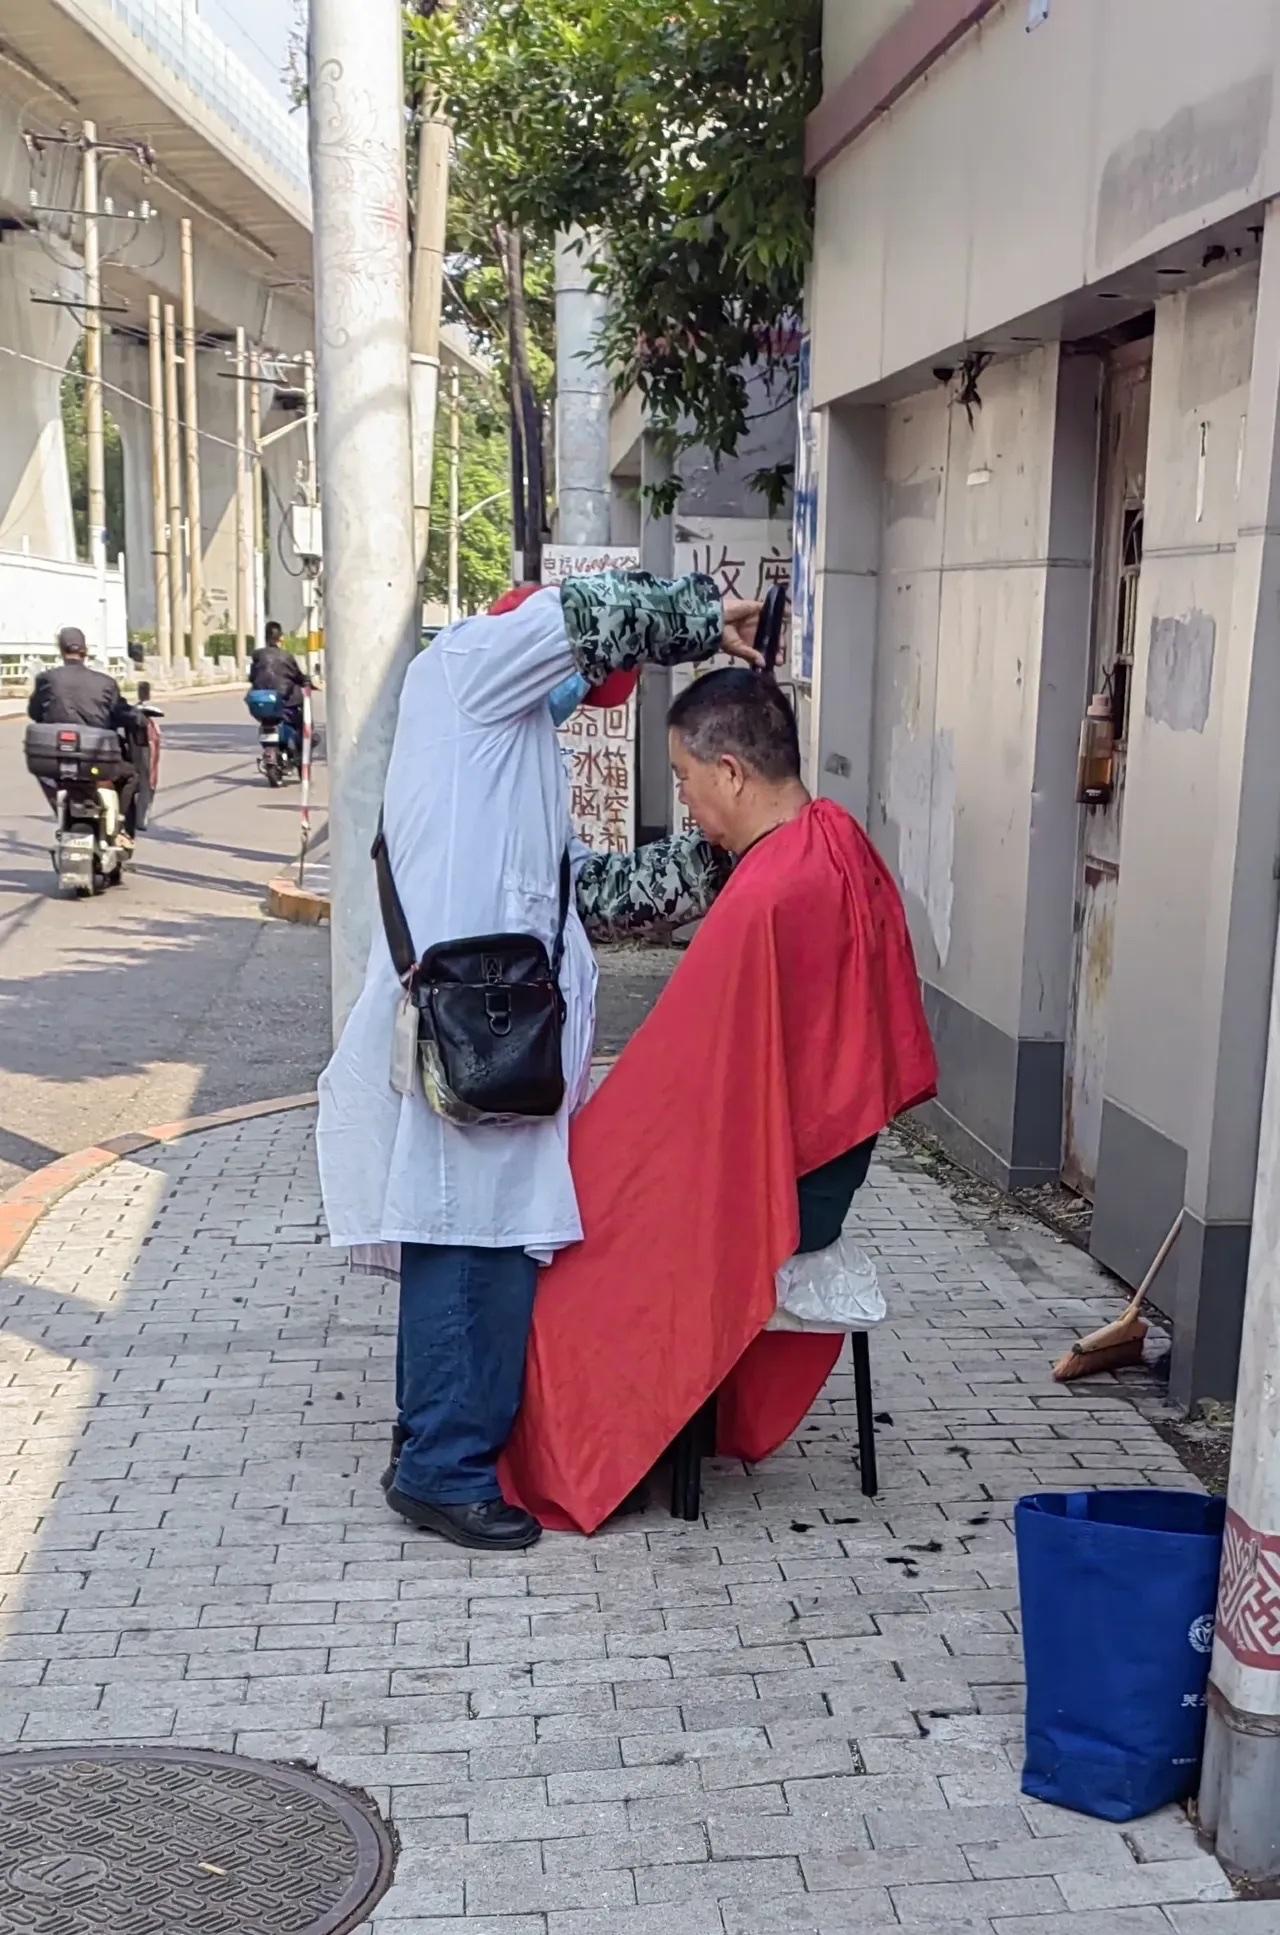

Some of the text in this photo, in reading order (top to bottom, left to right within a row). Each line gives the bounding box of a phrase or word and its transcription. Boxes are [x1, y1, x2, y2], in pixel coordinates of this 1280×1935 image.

[556, 704, 633, 741] 器回
[572, 744, 629, 789] 冰箱
[571, 783, 629, 824] 脑空
